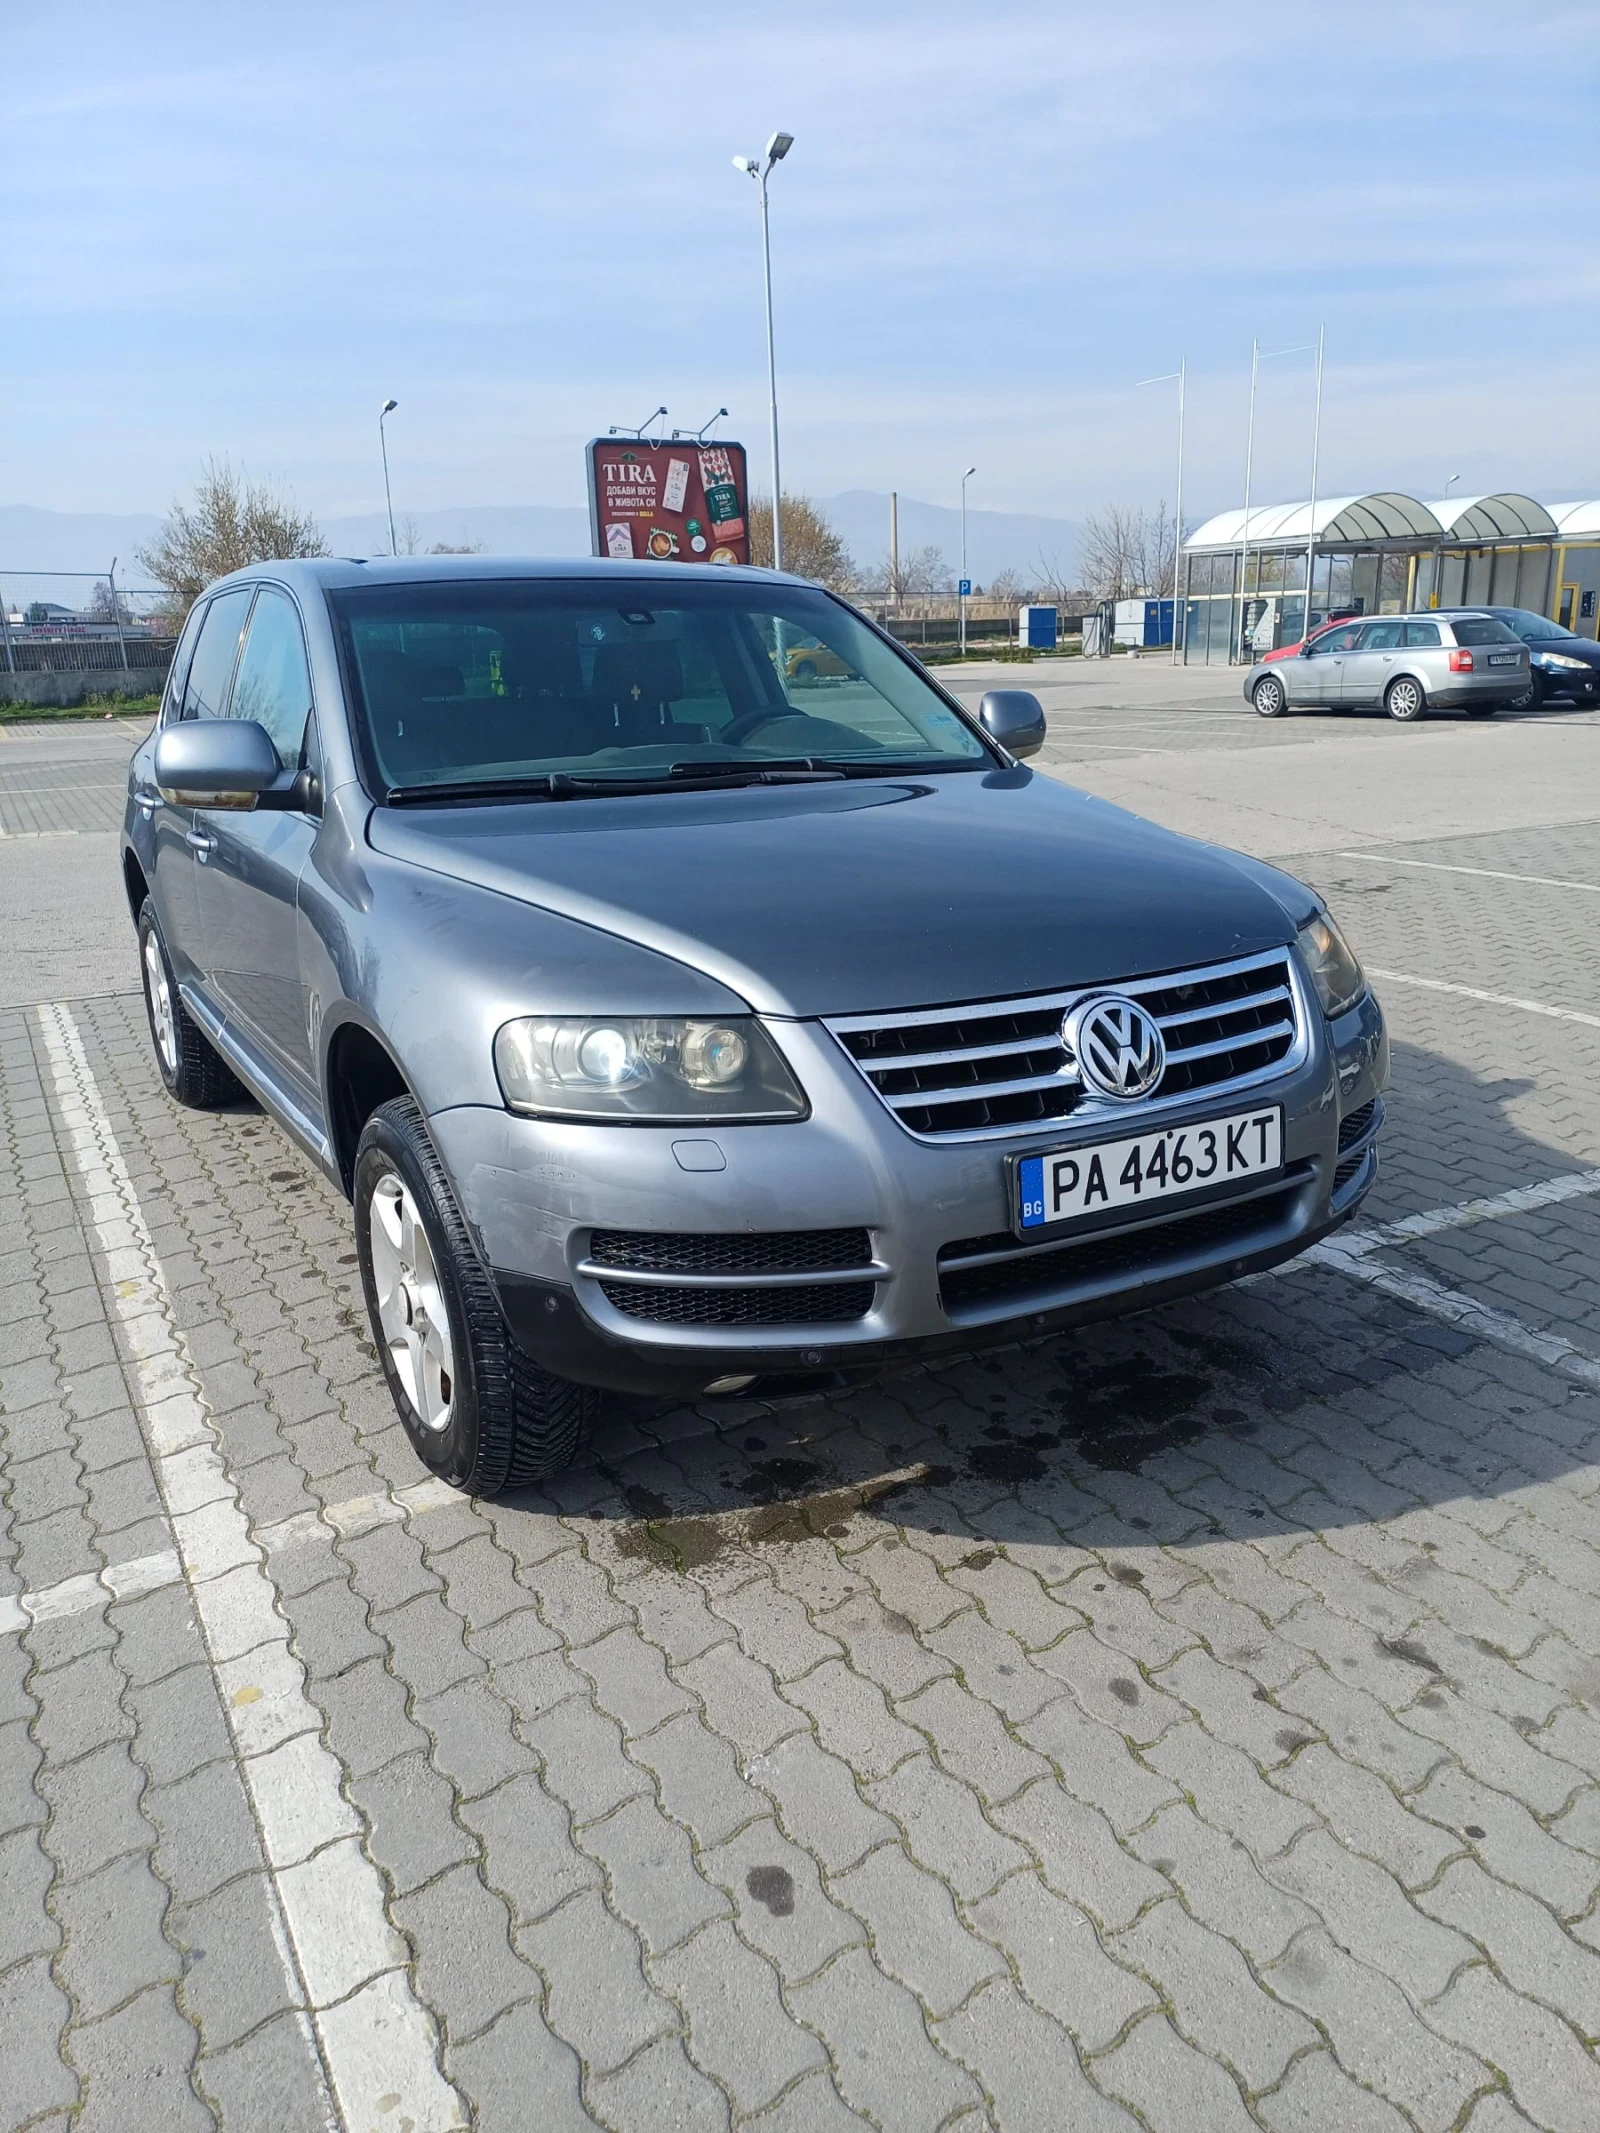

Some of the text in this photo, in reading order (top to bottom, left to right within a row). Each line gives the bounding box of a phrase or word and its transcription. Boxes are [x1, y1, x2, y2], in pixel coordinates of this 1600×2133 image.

[603, 464, 657, 484] TIRA
[606, 486, 656, 496] ДОБАВИ ВКУС
[608, 498, 656, 507] В ЖИВОТА СИ
[961, 581, 969, 594] P
[1052, 1114, 1275, 1213] PA 4463 KT
[1023, 1201, 1043, 1218] BG
